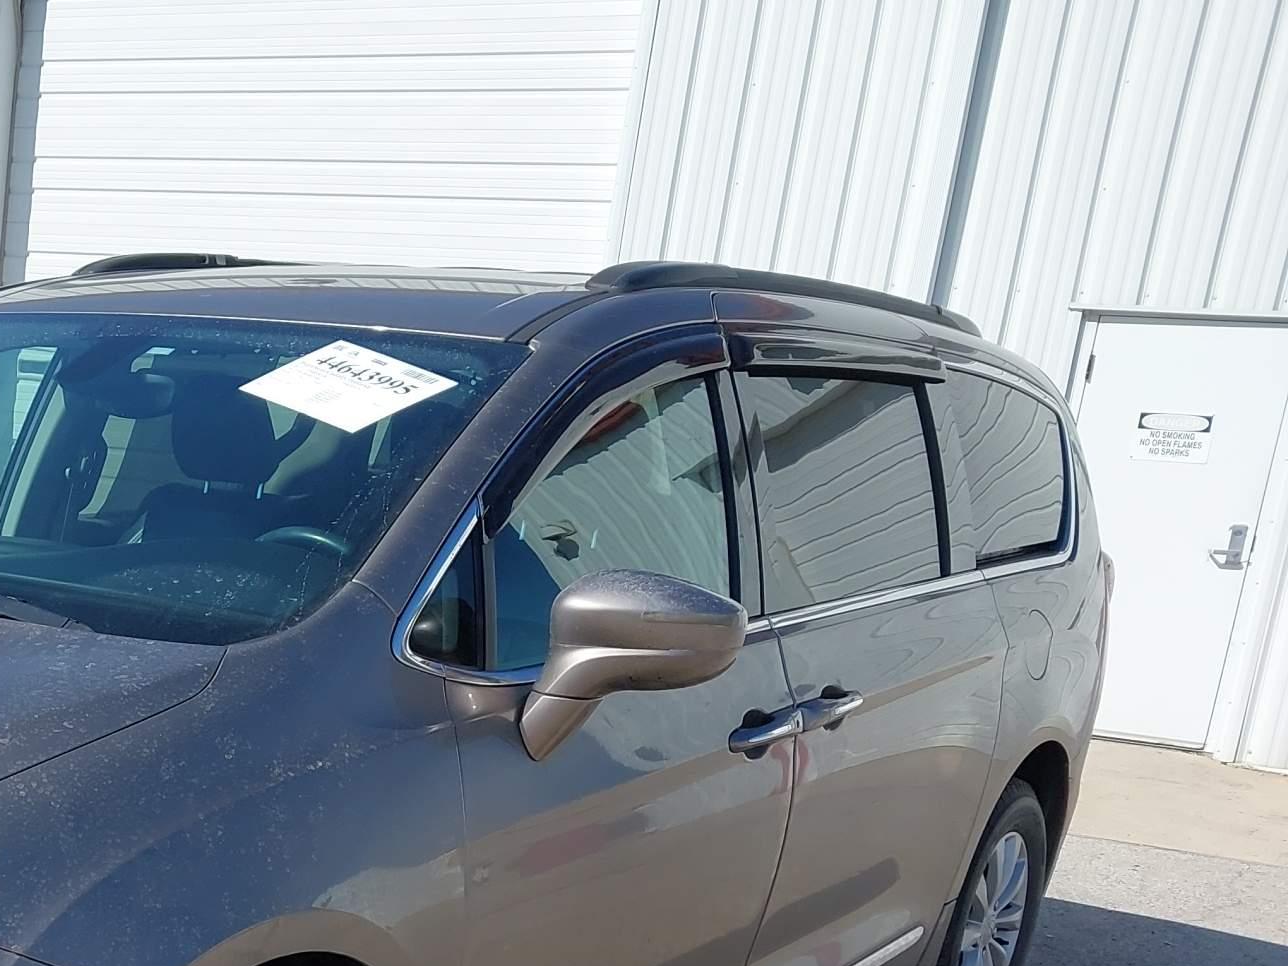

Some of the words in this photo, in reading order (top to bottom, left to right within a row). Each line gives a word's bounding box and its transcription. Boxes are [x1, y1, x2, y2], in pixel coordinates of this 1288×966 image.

[316, 355, 419, 395] 44643995
[1149, 430, 1161, 439] NO
[1162, 431, 1196, 441] SMOKING
[1139, 438, 1151, 446] NO
[1151, 439, 1172, 448] OPEN
[1172, 440, 1203, 450] FLAMES
[1148, 447, 1160, 455] NO
[1160, 448, 1190, 457] SPARKS
